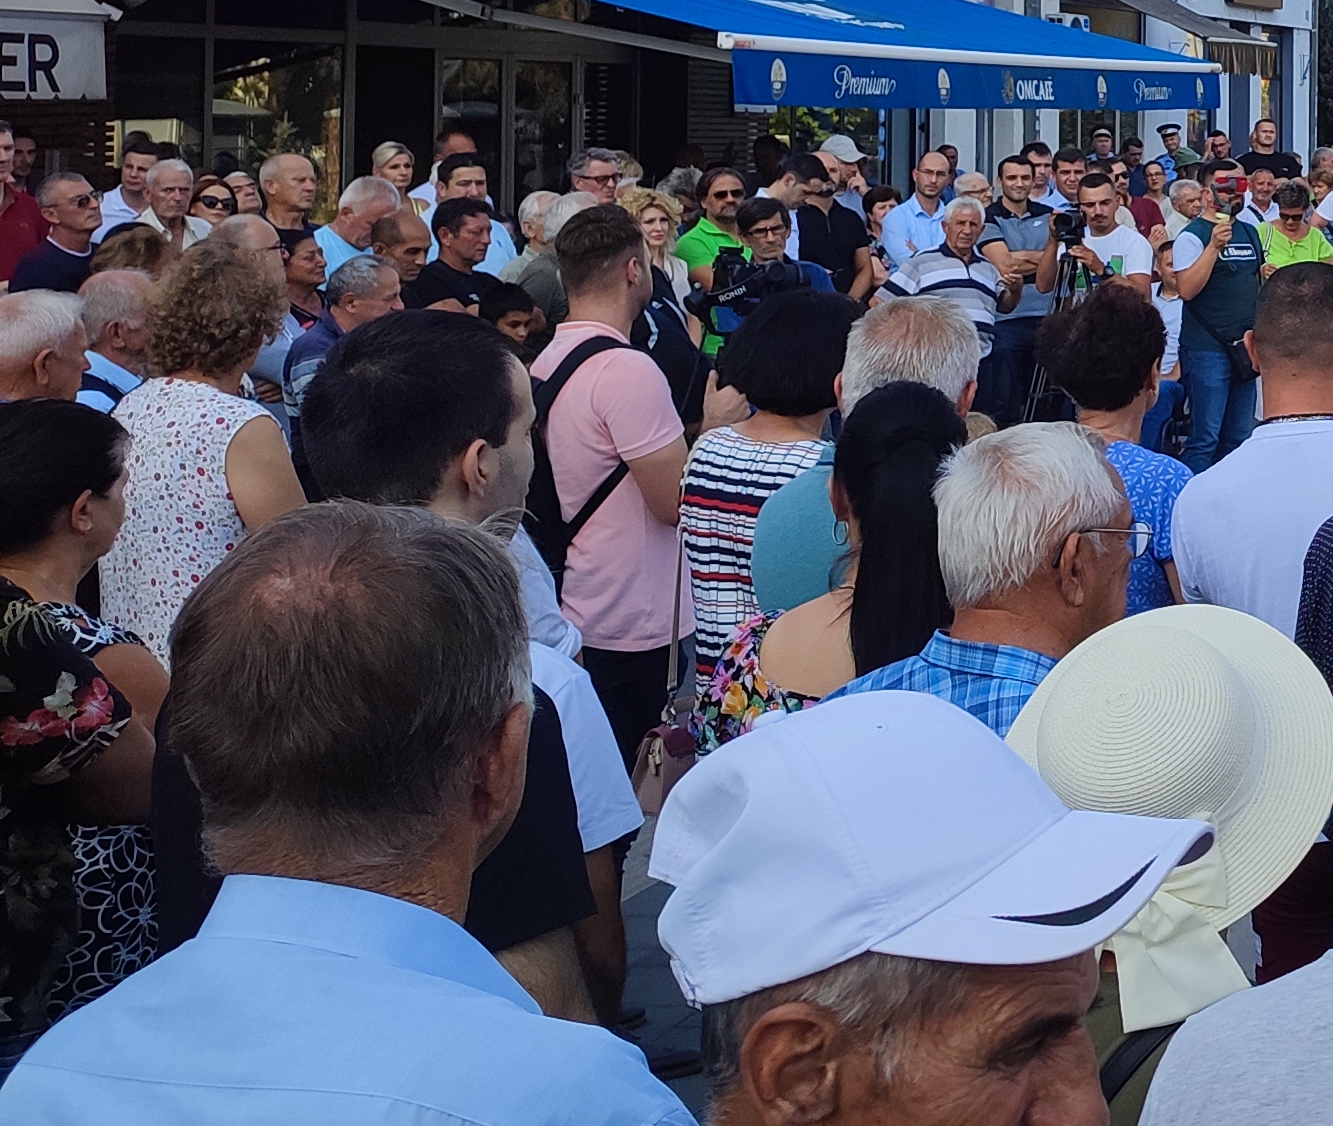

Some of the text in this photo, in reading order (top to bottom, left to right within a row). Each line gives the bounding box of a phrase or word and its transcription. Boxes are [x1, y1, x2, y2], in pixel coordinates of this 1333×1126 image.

[833, 64, 897, 100] Premium
[1134, 77, 1173, 105] Premium
[718, 284, 748, 304] RONIN
